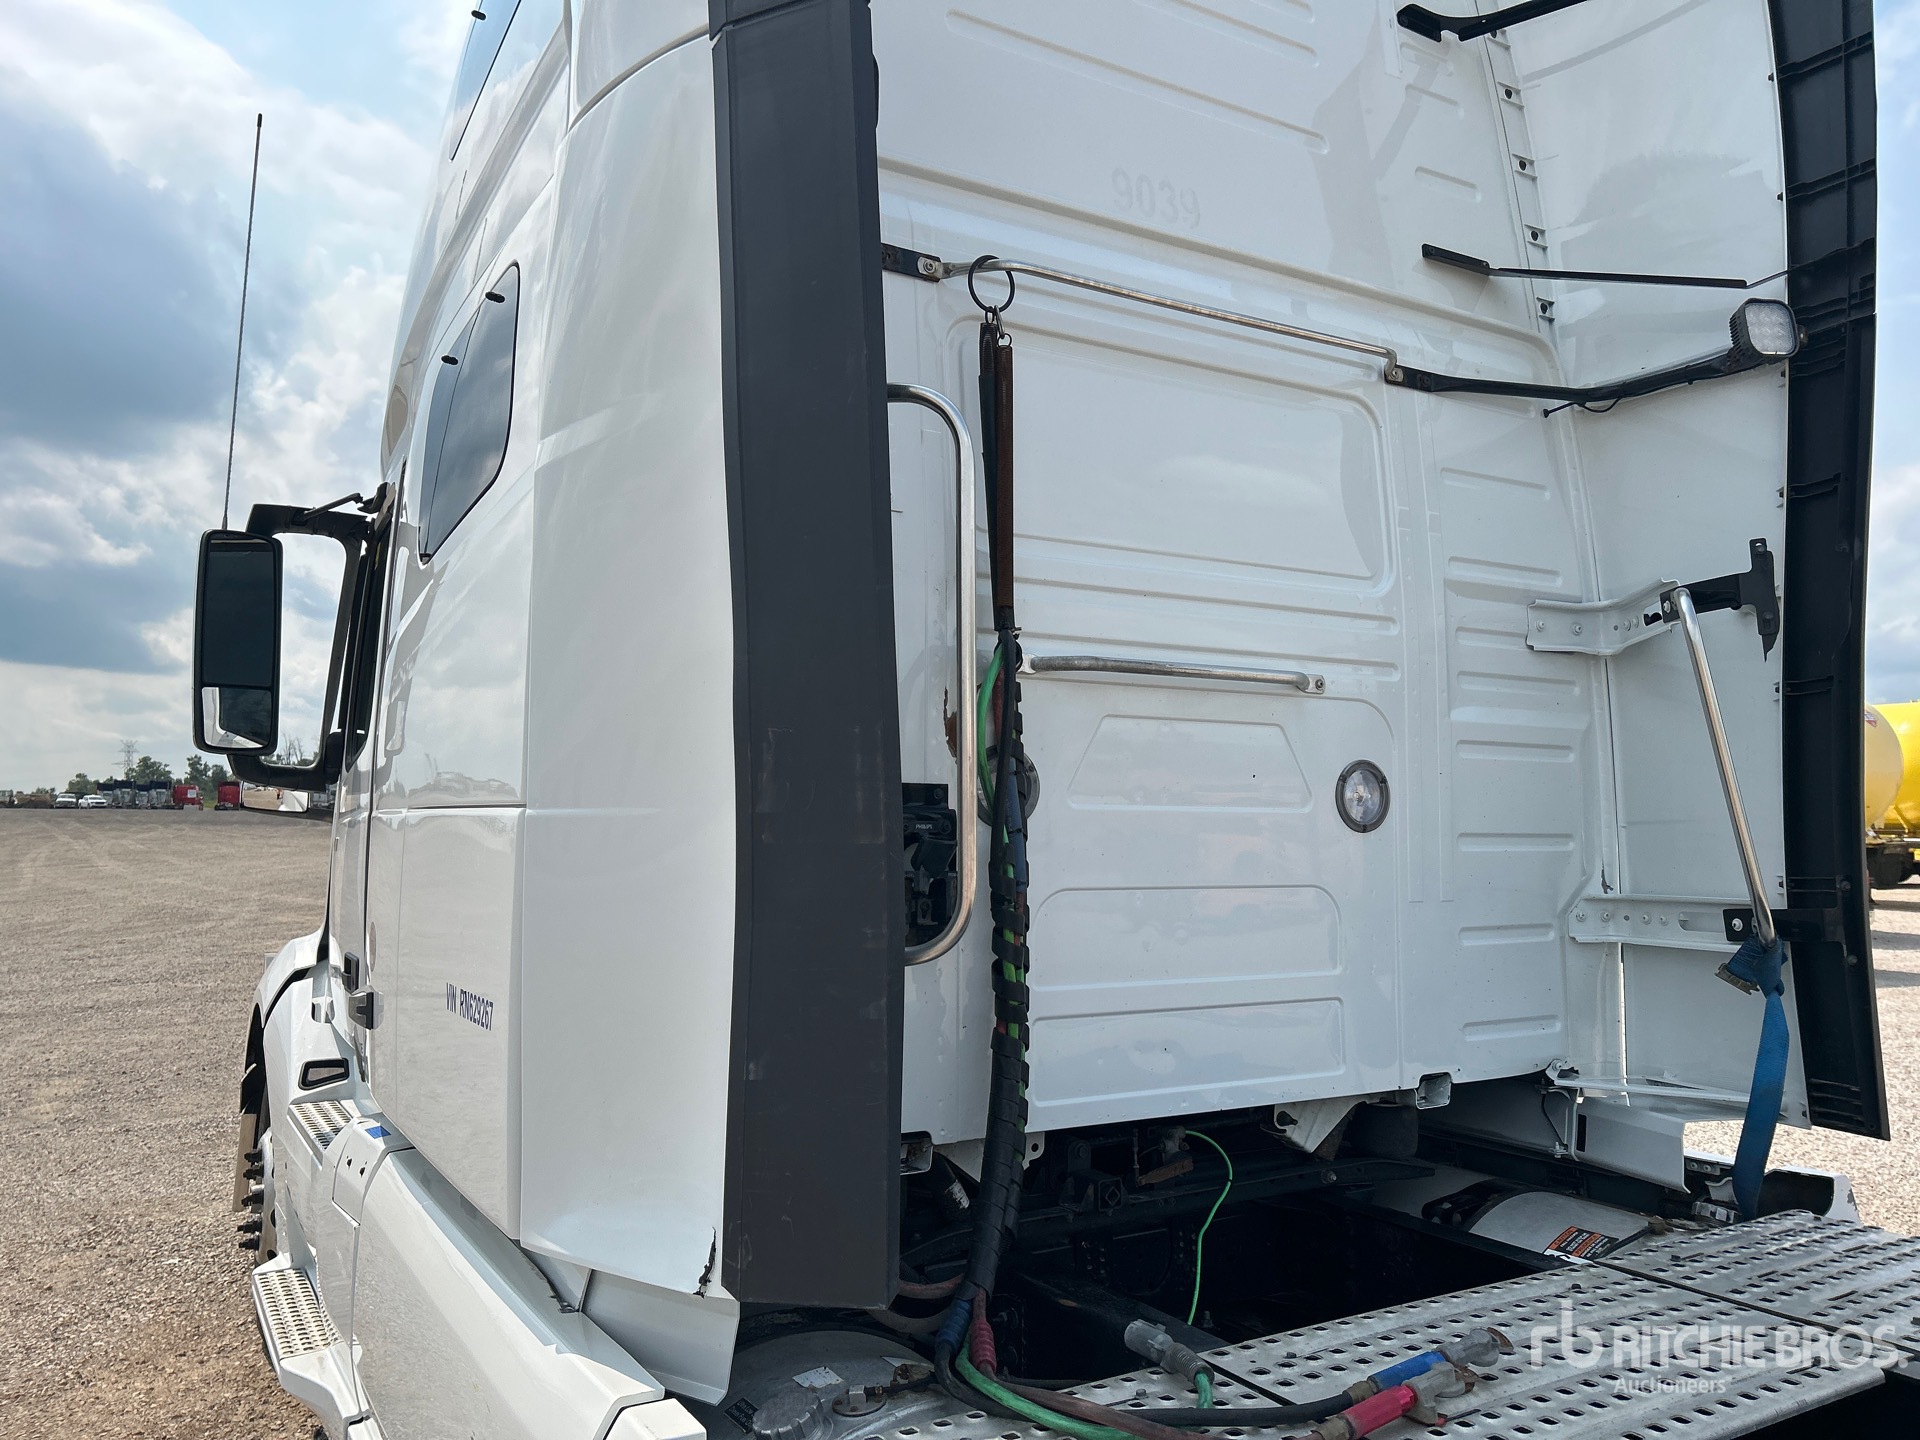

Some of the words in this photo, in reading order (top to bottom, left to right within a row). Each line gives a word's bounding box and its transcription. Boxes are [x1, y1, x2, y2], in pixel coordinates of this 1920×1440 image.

[1112, 167, 1200, 229] 9039
[446, 982, 456, 1014] VIN
[460, 988, 493, 1031] RN629267
